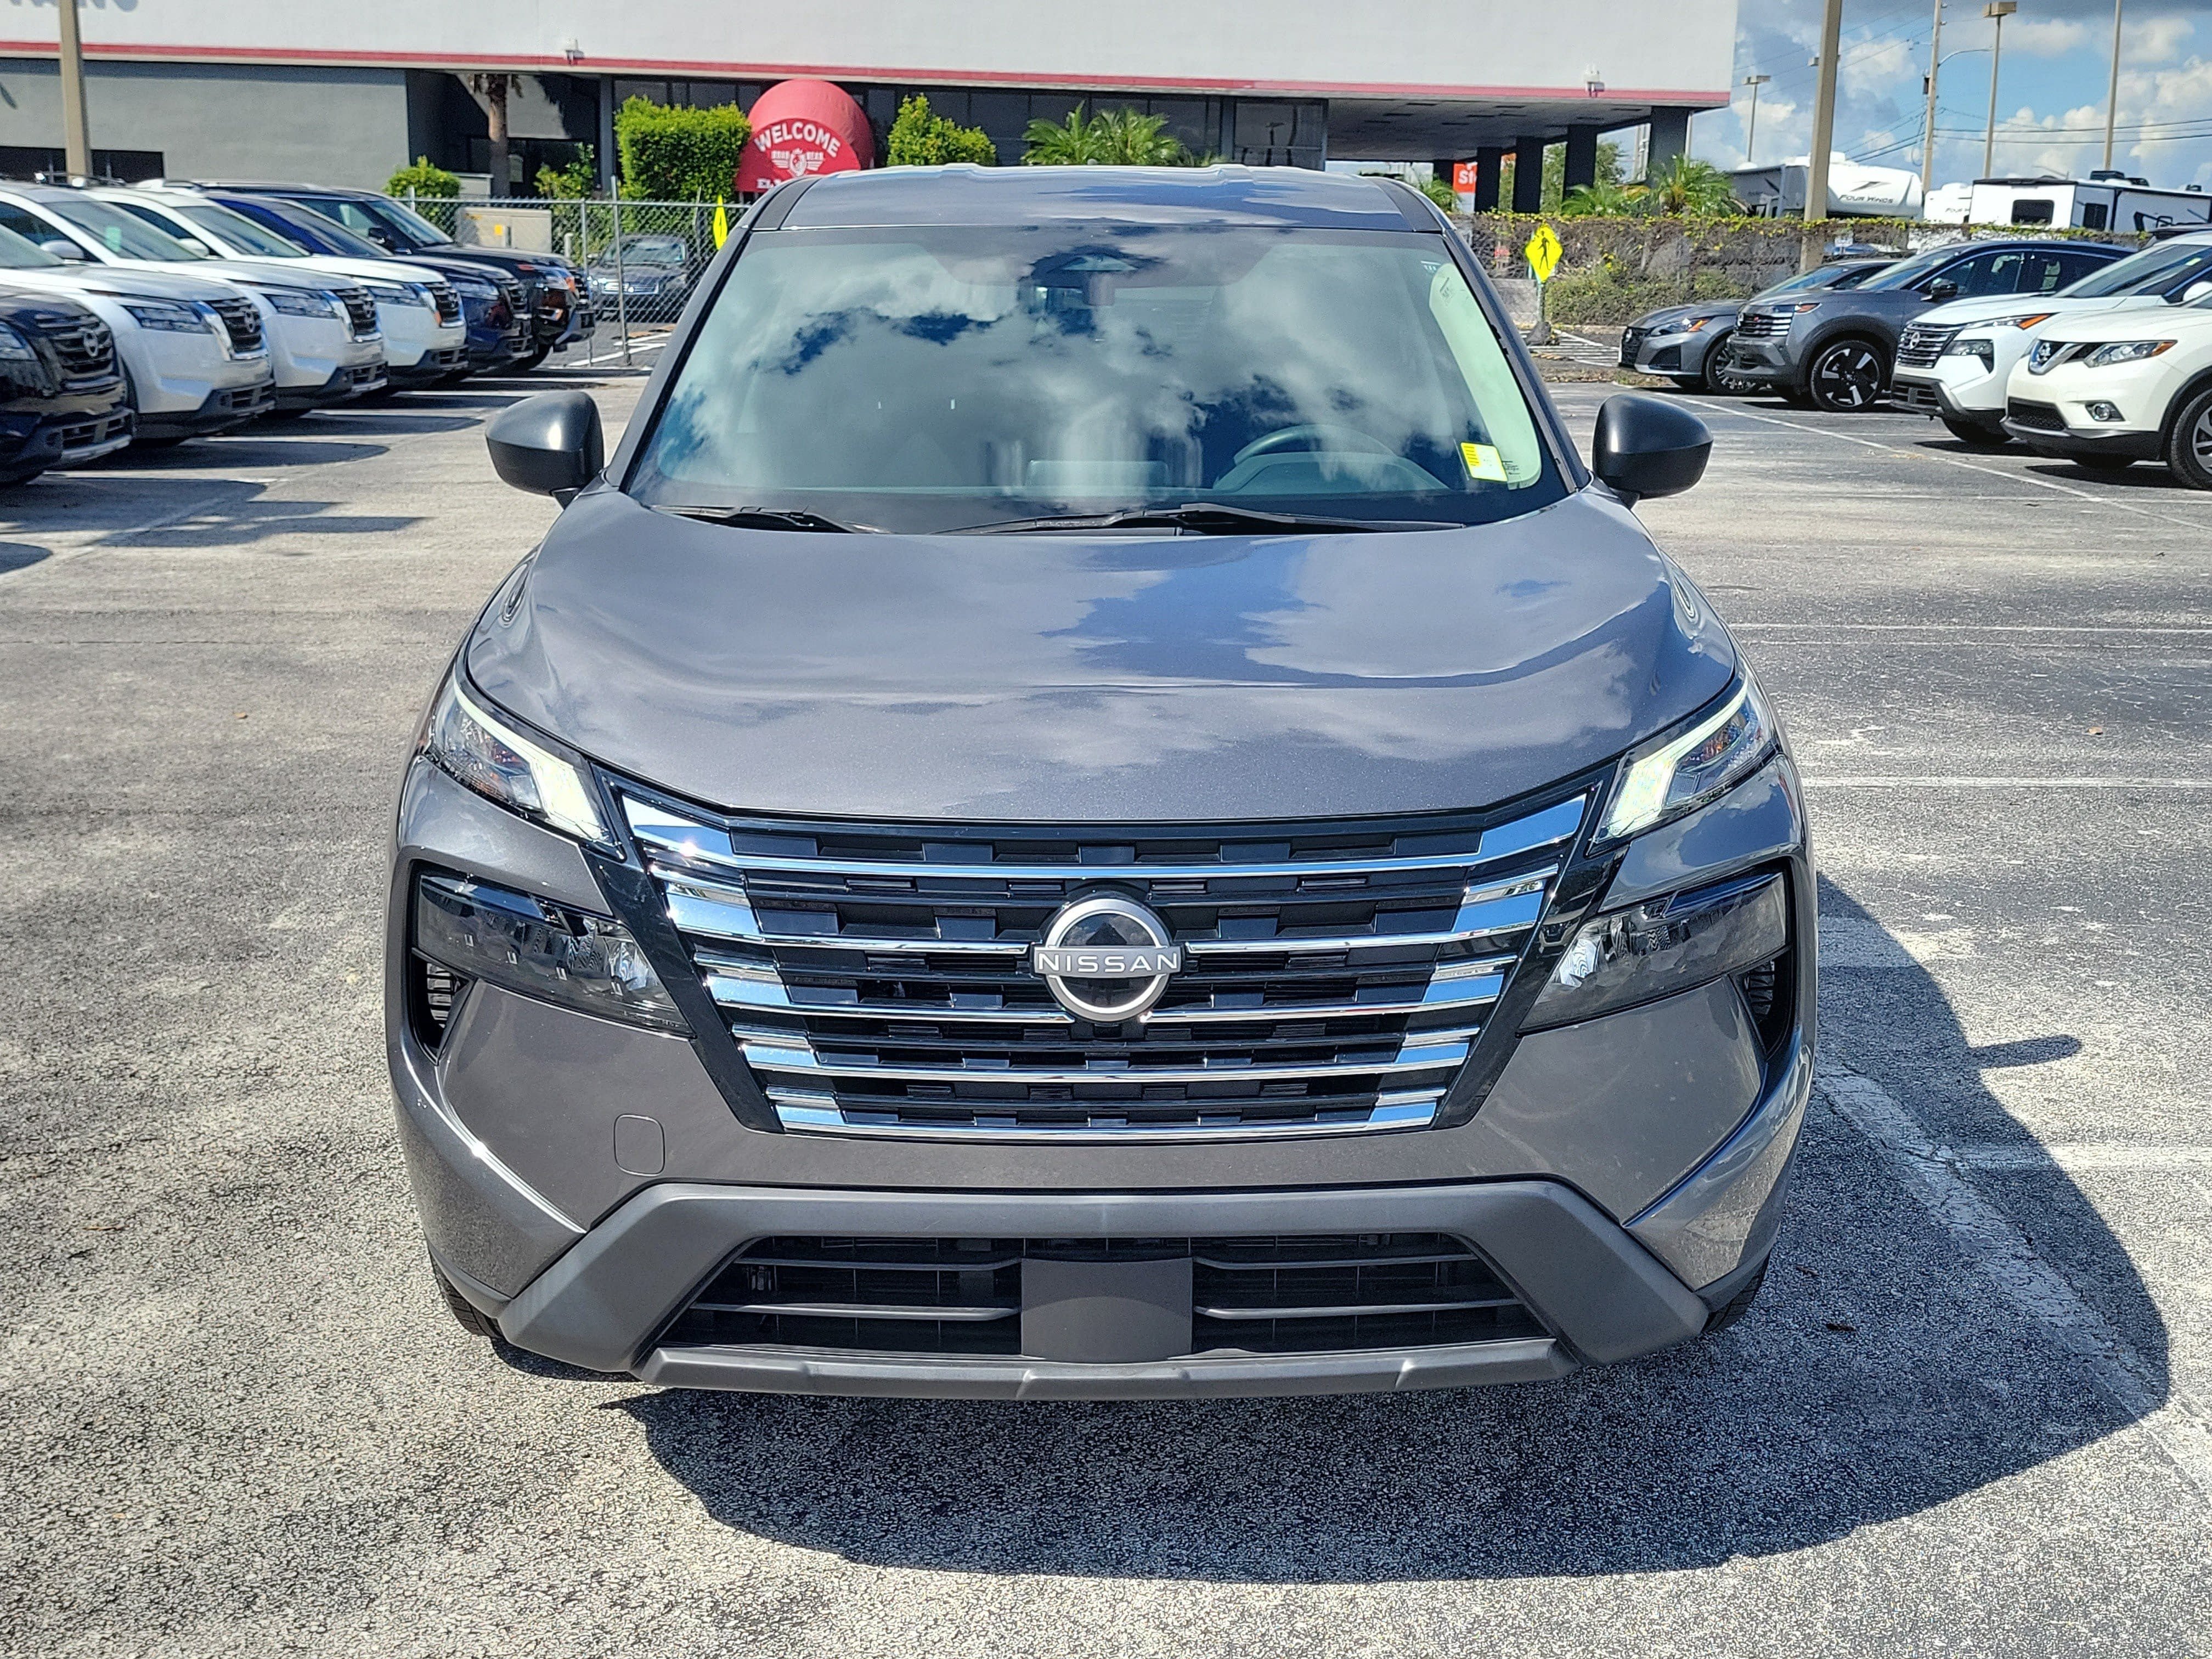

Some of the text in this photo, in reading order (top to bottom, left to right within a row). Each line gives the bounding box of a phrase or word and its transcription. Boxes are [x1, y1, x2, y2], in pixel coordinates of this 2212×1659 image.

[754, 121, 841, 157] WELCOME
[1458, 170, 1477, 184] St
[1037, 952, 1178, 973] NISSAN
